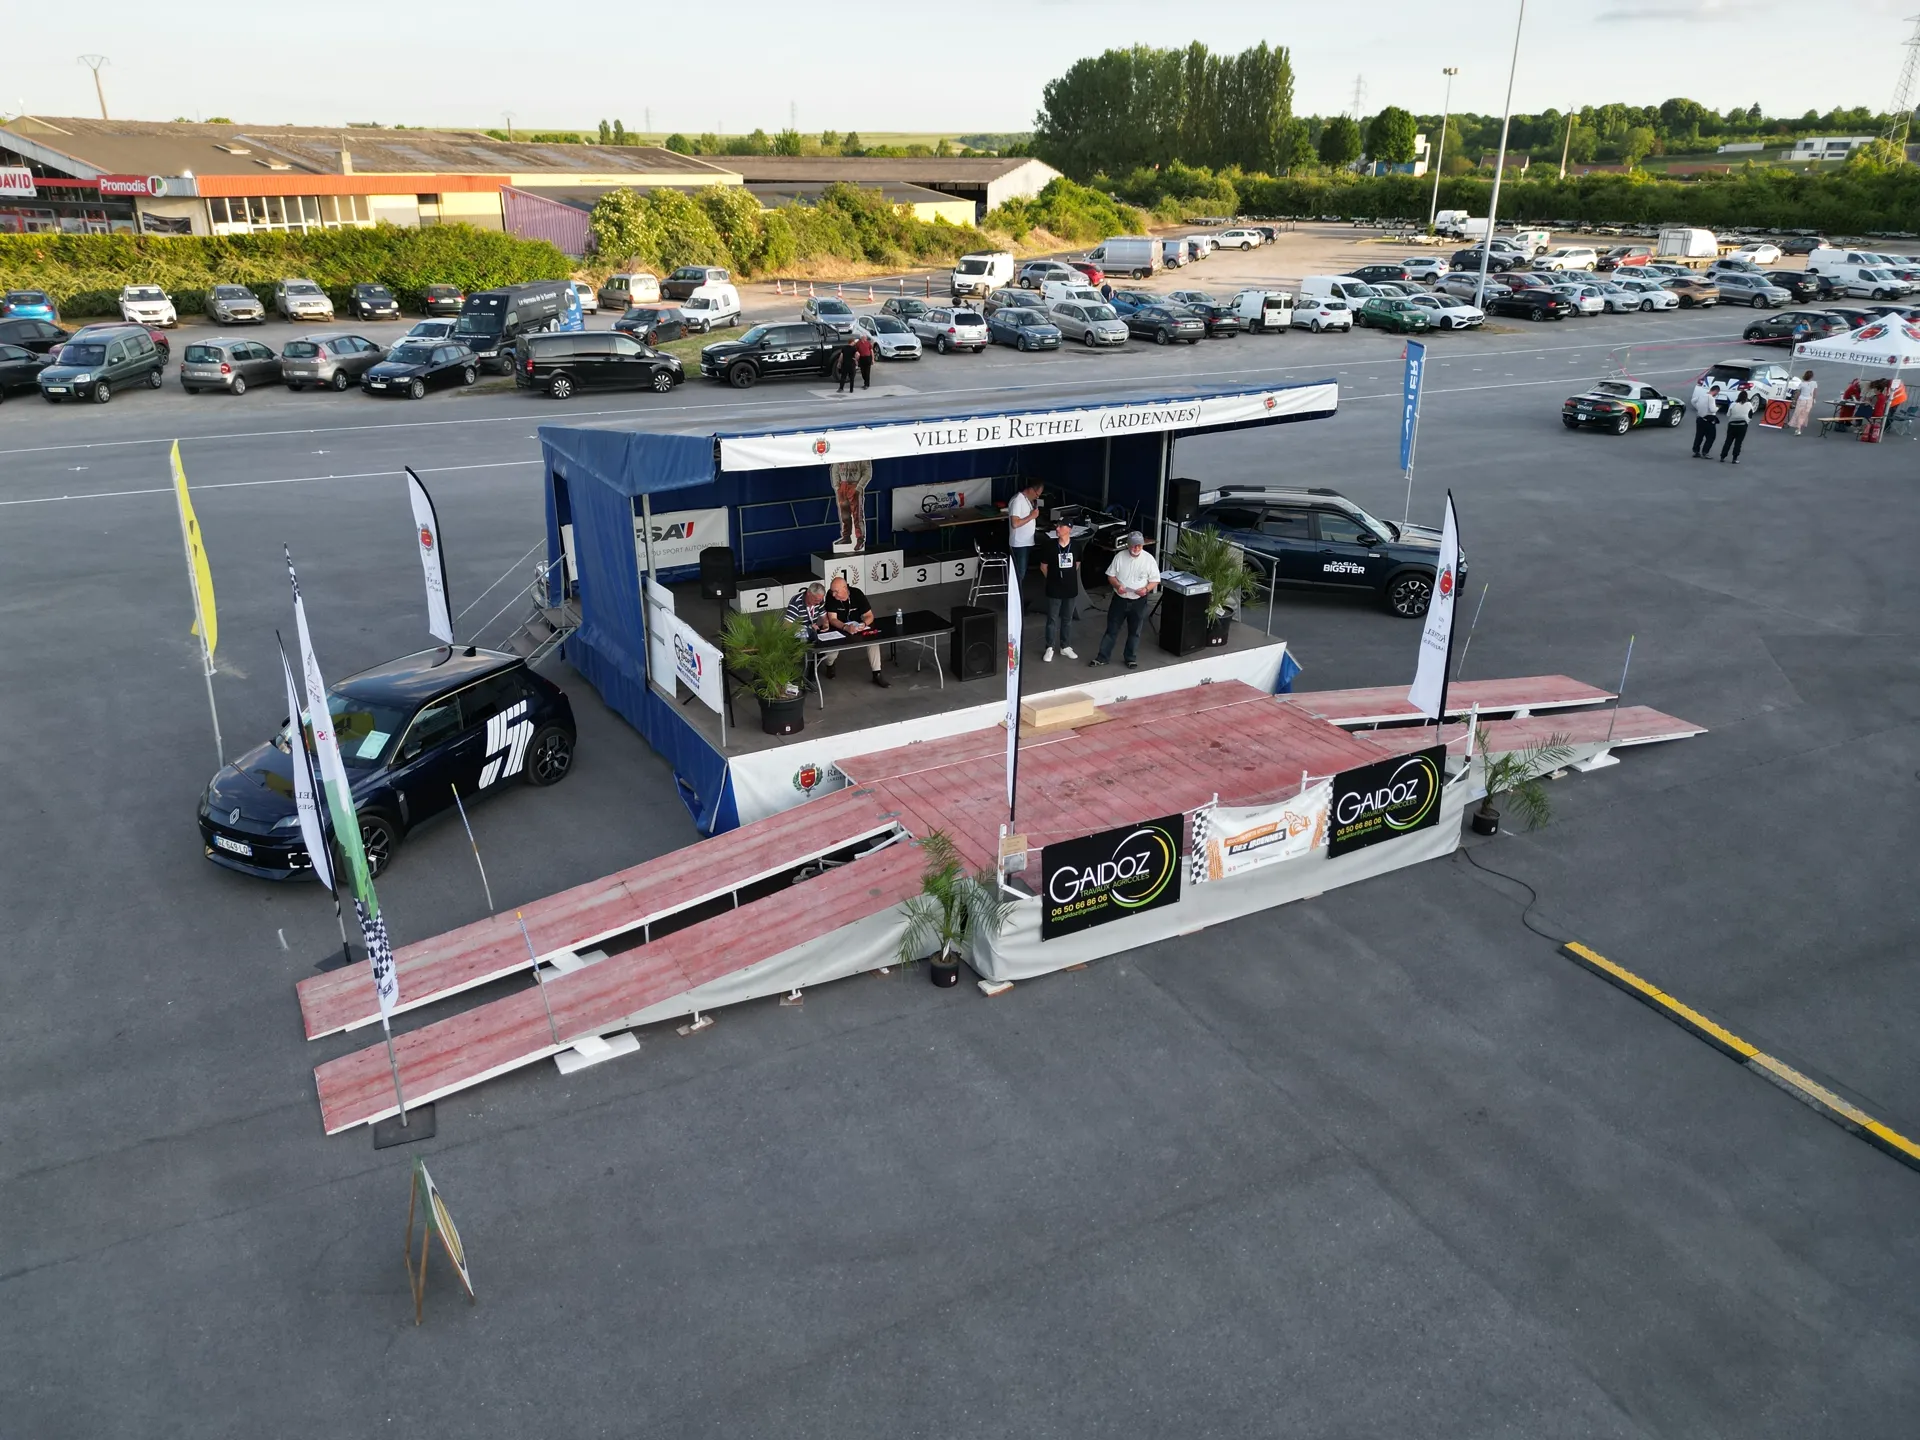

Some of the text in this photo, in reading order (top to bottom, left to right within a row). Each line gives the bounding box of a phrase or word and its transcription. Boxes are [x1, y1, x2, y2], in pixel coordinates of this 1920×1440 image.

[100, 178, 146, 193] Promodis
[1810, 348, 1882, 363] VILLE DE RETHEL
[913, 405, 1201, 447] VILLE DE RETHEL (ARDENNES)
[663, 547, 683, 556] SPORT
[881, 563, 890, 581] 1
[917, 568, 927, 582] 3
[955, 562, 965, 577] 3
[1323, 564, 1365, 574] BIGSTER
[756, 592, 769, 608] 2
[1337, 778, 1418, 825] GAIDOZ
[1360, 799, 1417, 819] TRAVAUX AGRICOLES
[1336, 828, 1345, 836] 06
[1345, 825, 1354, 833] 50
[1049, 851, 1150, 903] GAIDOZ
[1080, 873, 1150, 897] TRAVAUX AGRICOLES
[1051, 894, 1108, 916] 06 50 66 86 06
